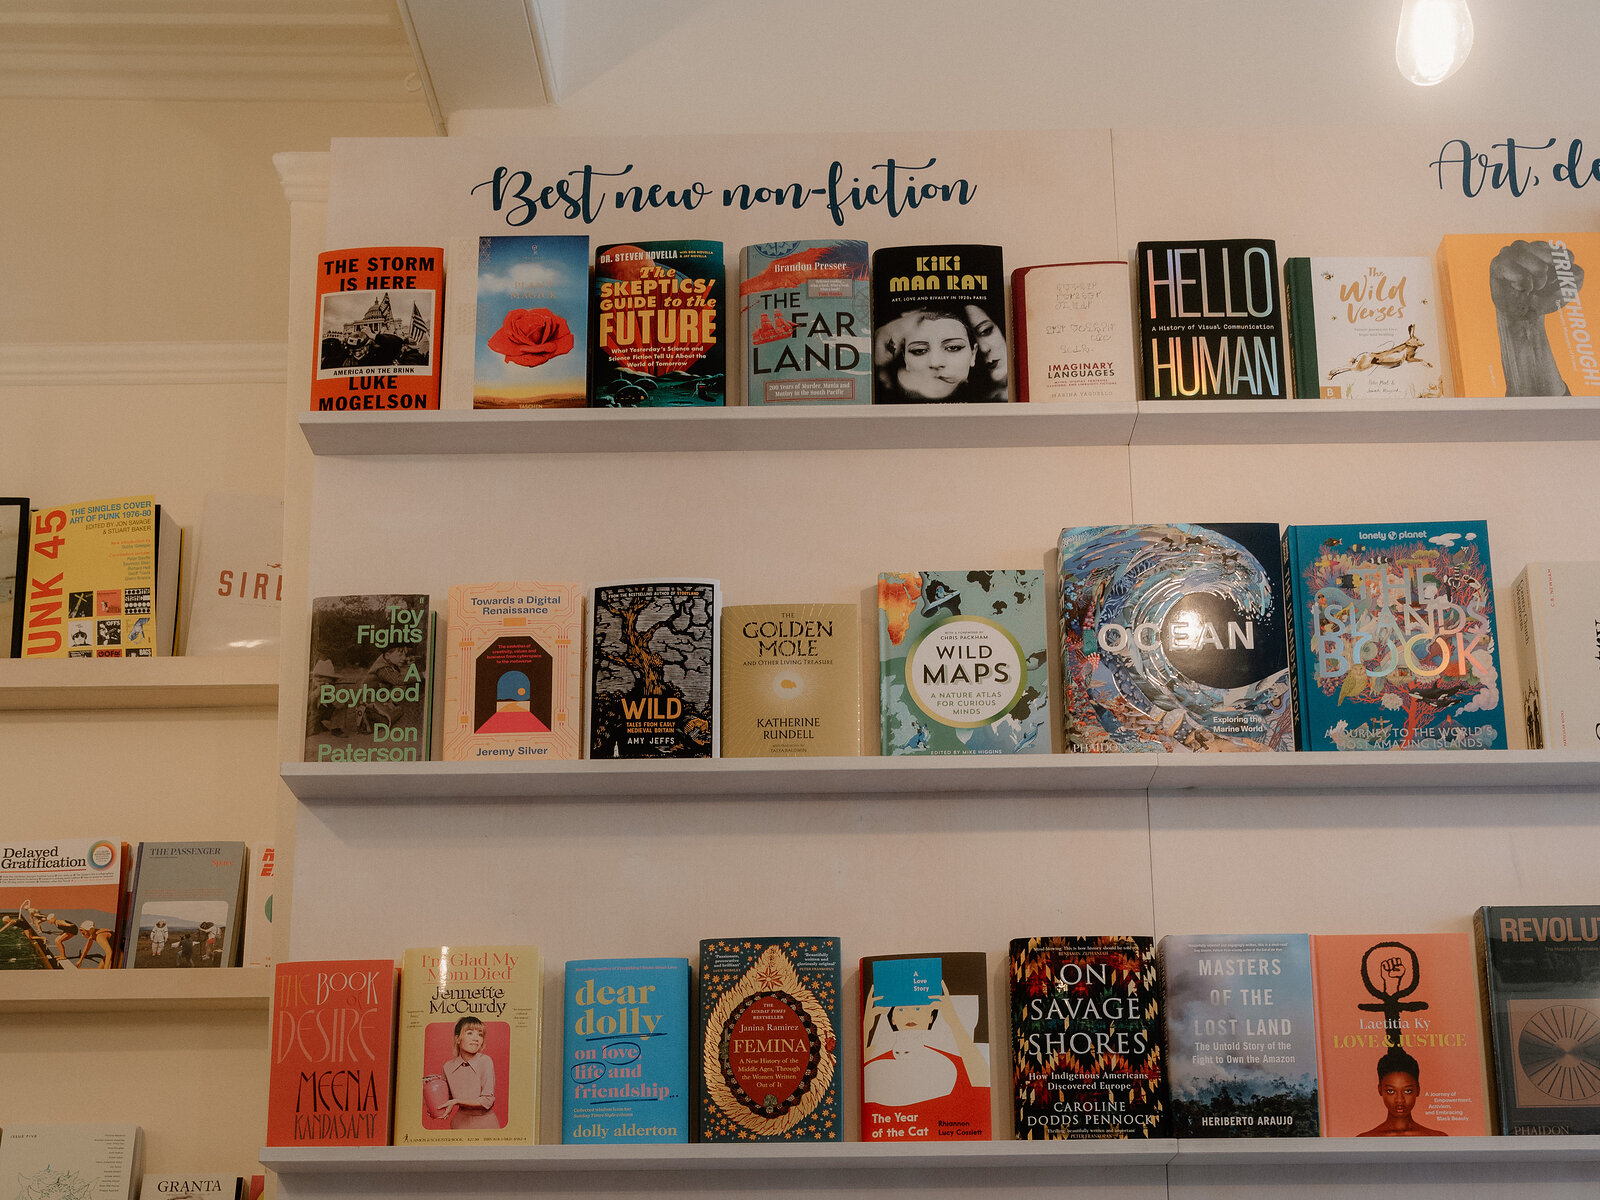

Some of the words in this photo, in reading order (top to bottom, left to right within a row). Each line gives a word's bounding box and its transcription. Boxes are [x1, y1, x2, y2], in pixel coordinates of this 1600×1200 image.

[1429, 138, 1556, 198] Art,
[471, 164, 634, 226] Best
[615, 180, 712, 213] new
[722, 157, 977, 227] non-fiction
[601, 254, 613, 263] DR.
[615, 252, 644, 262] STEVEN
[645, 251, 677, 260] NOVELLA
[324, 260, 359, 275] THE
[368, 257, 434, 272] STORM
[775, 262, 812, 273] Brandon
[814, 261, 847, 270] Presser
[1368, 267, 1384, 277] The
[890, 275, 940, 292] MAN
[948, 274, 988, 290] RAY
[1147, 247, 1273, 318] HELLO
[1340, 276, 1407, 306] Wild
[600, 309, 716, 346] FUTURE
[792, 311, 856, 338] FAR
[753, 344, 859, 374] LAND
[1049, 362, 1113, 371] IMAGINARY
[1152, 336, 1279, 397] HUMAN
[1048, 369, 1115, 379] LANGUAGES
[349, 376, 398, 391] LUKE
[319, 395, 427, 411] MOGELSON
[71, 508, 85, 516] THE
[87, 503, 121, 514] SINGLES
[123, 501, 152, 510] COVER
[70, 515, 85, 525] ART
[87, 514, 96, 522] OF
[98, 512, 120, 521] PUNK
[123, 510, 151, 519] 1976-80
[34, 509, 67, 559] 45
[1359, 532, 1386, 541] lonely
[1399, 530, 1427, 540] planet
[472, 597, 514, 606] Towards
[526, 596, 560, 606] Digital
[387, 606, 424, 626] Toy
[483, 606, 548, 615] Renaissance
[357, 625, 423, 648] Fights
[742, 621, 833, 639] GOLDEN
[1099, 622, 1255, 652] OCEAN
[759, 640, 818, 657] MOLE
[936, 646, 992, 659] WILD
[1318, 632, 1488, 678] BOOK
[404, 664, 421, 682] A
[924, 663, 1009, 684] MAPS
[320, 683, 419, 707] Boyhood
[622, 698, 681, 719] WILD
[757, 717, 820, 728] KATHERINE
[374, 723, 417, 742] Don
[764, 730, 814, 739] RUNDELL
[318, 745, 417, 762] Paterson
[3, 847, 58, 859] Delayed
[170, 847, 220, 855] PASSENGER
[1, 857, 86, 869] Gratification
[1500, 916, 1600, 943] REVOLU
[1060, 964, 1107, 985] ON
[1199, 959, 1281, 976] MASTERS
[317, 972, 380, 1005] BOOK
[432, 986, 504, 1000] Jennette
[575, 979, 655, 1005] dear
[429, 1000, 507, 1017] McCurdy
[1031, 999, 1140, 1021] SAVAGE
[575, 1007, 664, 1040] dolly
[739, 1024, 764, 1032] Janina
[1195, 1019, 1238, 1036] LOST
[1247, 1019, 1291, 1035] LAND
[733, 1039, 807, 1053] FEMINA
[1028, 1032, 1146, 1055] SHORES
[296, 1070, 378, 1112] MEENA
[872, 1114, 892, 1123] The
[895, 1113, 918, 1122] Year
[1202, 1116, 1254, 1126] HERIBERTO
[1257, 1116, 1293, 1125] ARAUJO
[872, 1129, 883, 1138] of
[887, 1128, 904, 1137] the
[908, 1127, 928, 1136] Cat
[158, 1180, 222, 1193] GRANTA
